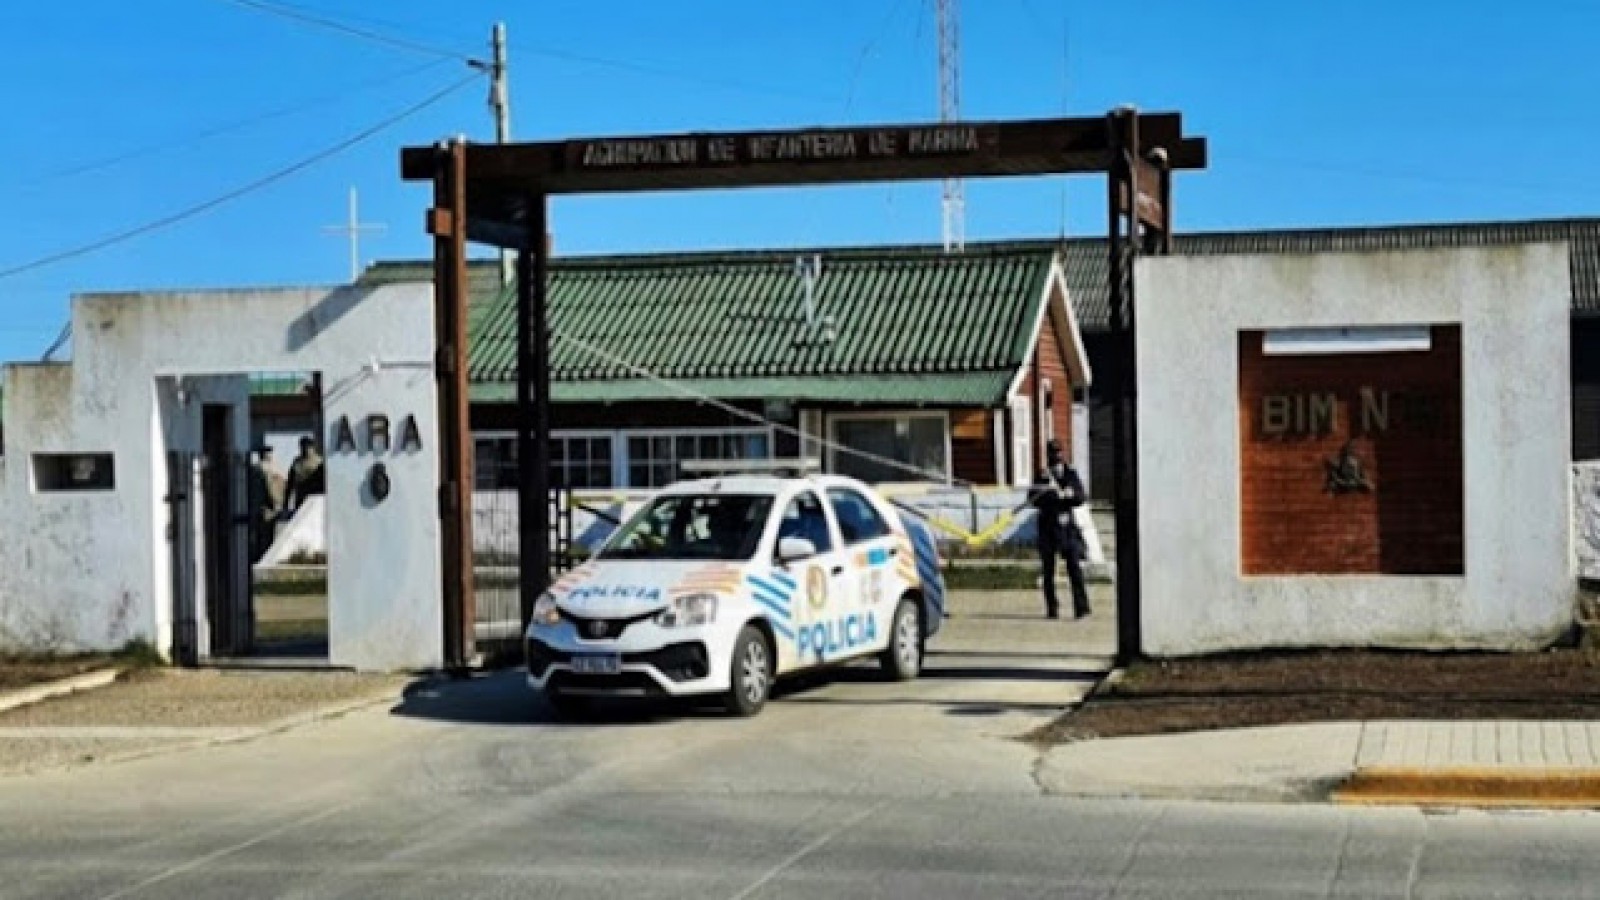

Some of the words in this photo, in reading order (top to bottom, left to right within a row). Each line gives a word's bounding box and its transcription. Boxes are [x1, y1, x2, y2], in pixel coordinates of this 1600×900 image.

[333, 413, 423, 451] ARA
[1262, 393, 1337, 432] BIM
[797, 612, 876, 657] POLICIA
